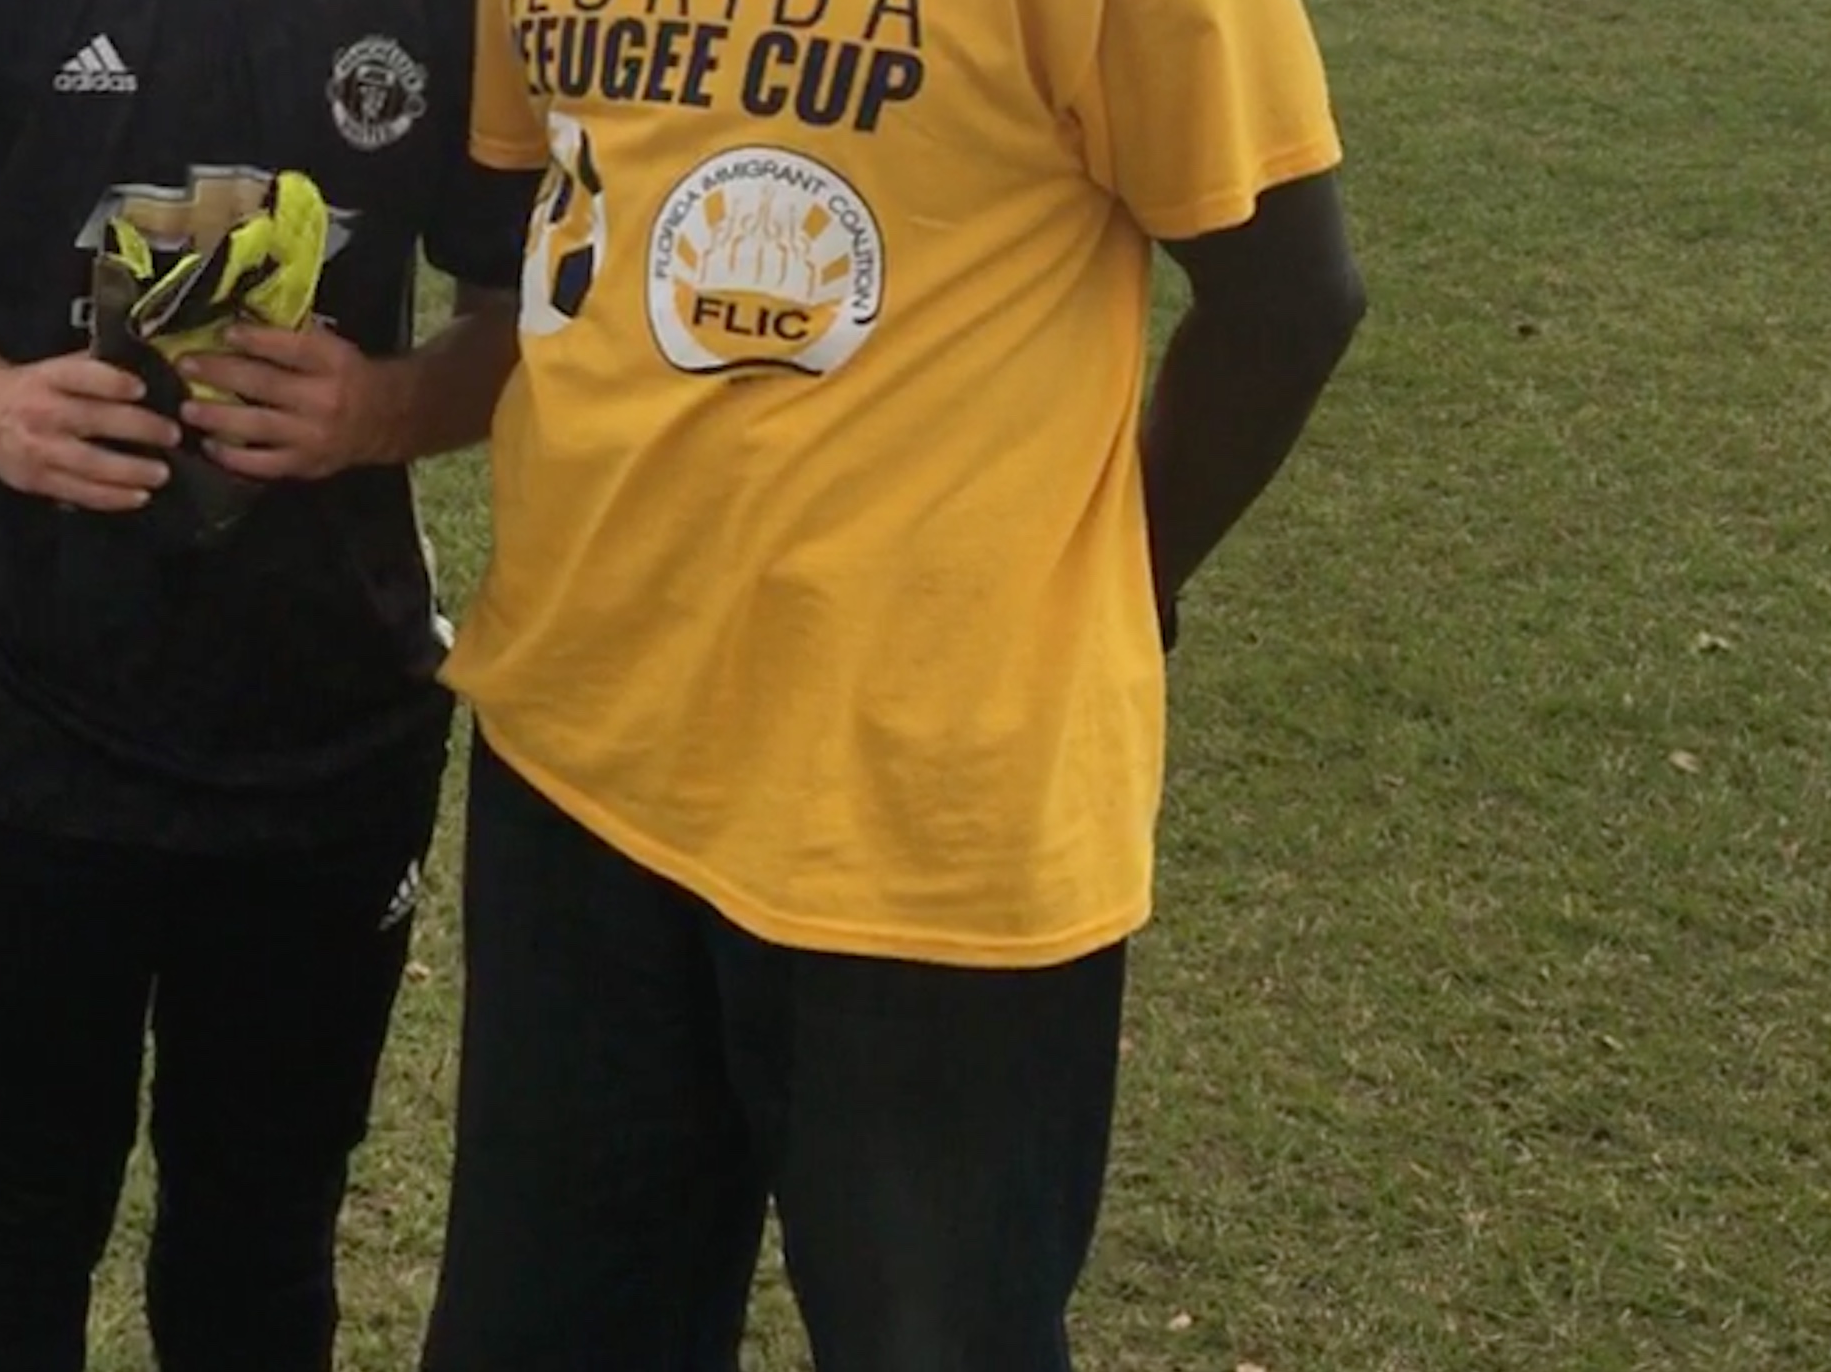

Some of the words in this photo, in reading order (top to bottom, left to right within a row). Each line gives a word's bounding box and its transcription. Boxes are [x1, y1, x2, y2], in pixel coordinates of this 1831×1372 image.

[53, 72, 138, 92] adidas
[515, 15, 729, 109] EFUGEE
[740, 29, 925, 134] CUP
[692, 296, 810, 342] FLIC
